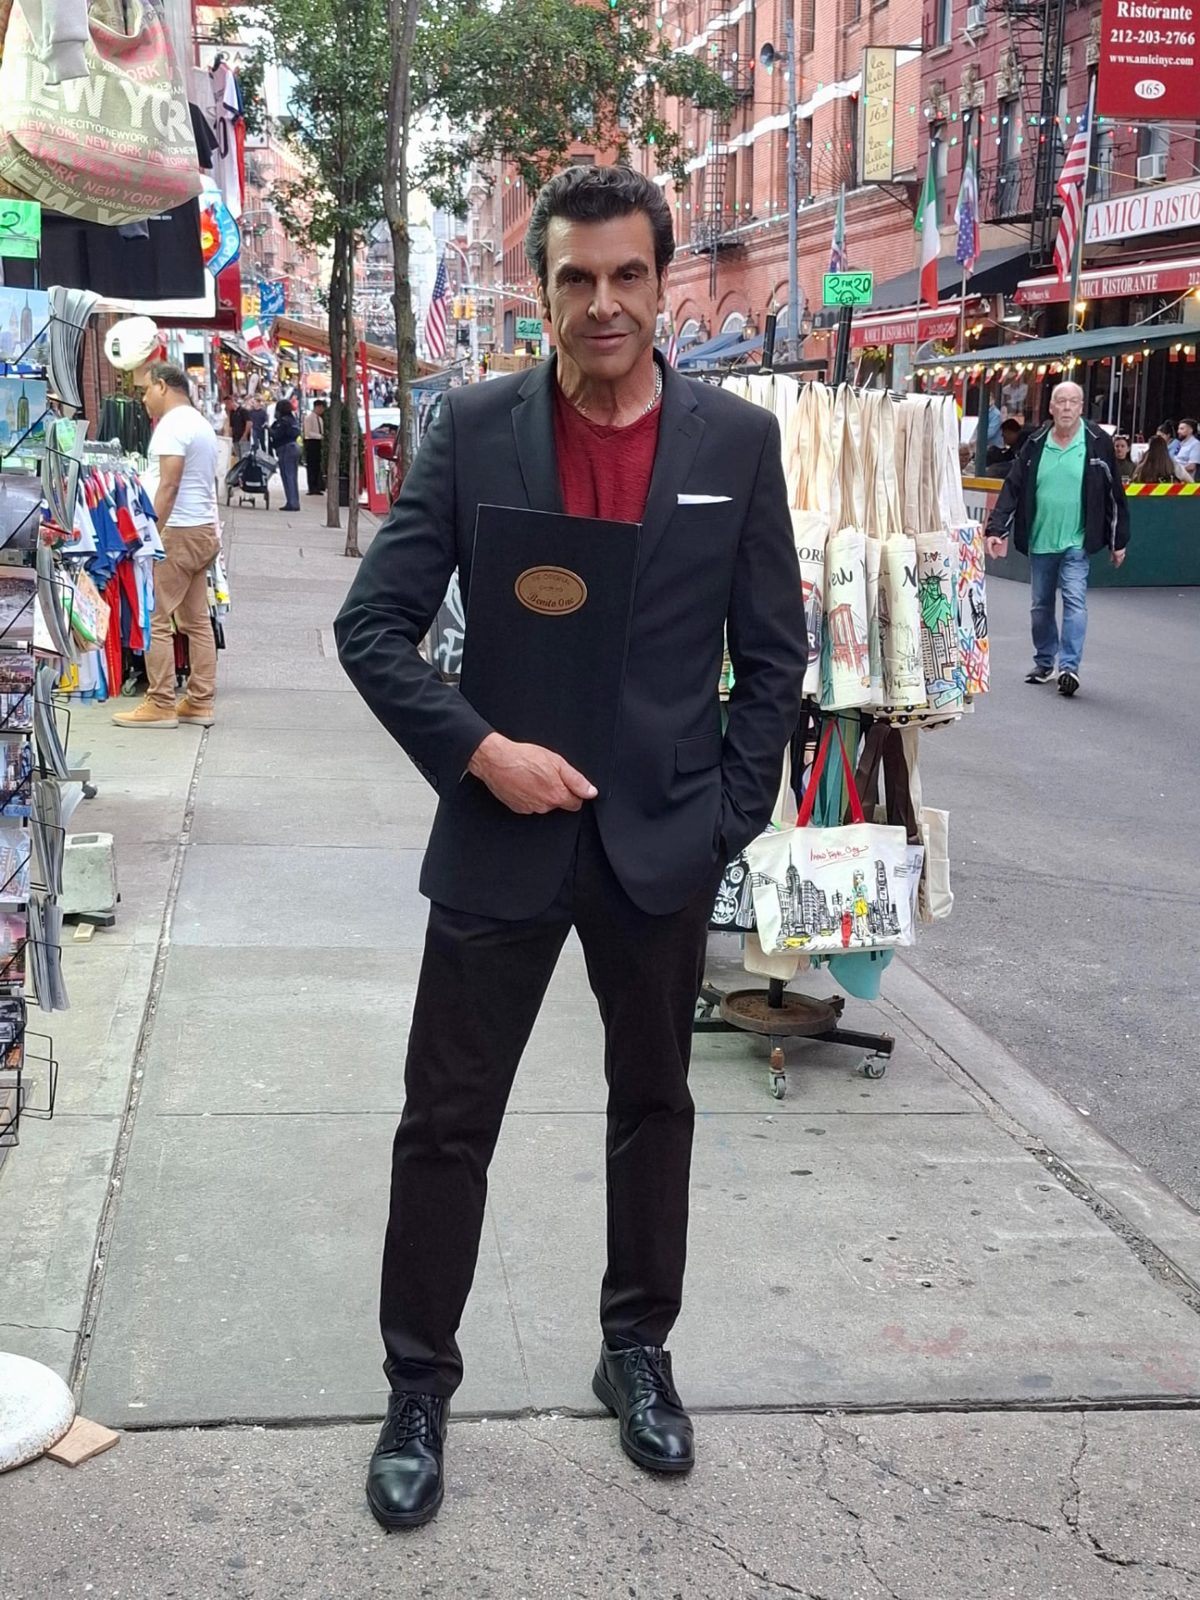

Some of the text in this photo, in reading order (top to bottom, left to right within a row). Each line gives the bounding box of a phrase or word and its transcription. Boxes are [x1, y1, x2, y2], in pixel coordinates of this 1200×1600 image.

[1117, 1, 1193, 20] Ristorante
[1110, 29, 1196, 45] 212-203-2766
[1109, 54, 1194, 67] www.amicinyc.com
[1139, 83, 1161, 95] 165
[20, 119, 46, 133] NEW
[48, 123, 80, 141] YORK
[85, 134, 110, 150] NEW
[111, 140, 142, 158] YORK
[83, 180, 121, 197] NEW
[122, 190, 162, 207] YORK
[1088, 194, 1150, 239] AMICI
[828, 276, 842, 295] 2
[853, 277, 871, 294] 20
[1102, 274, 1158, 297] RISTORANTE
